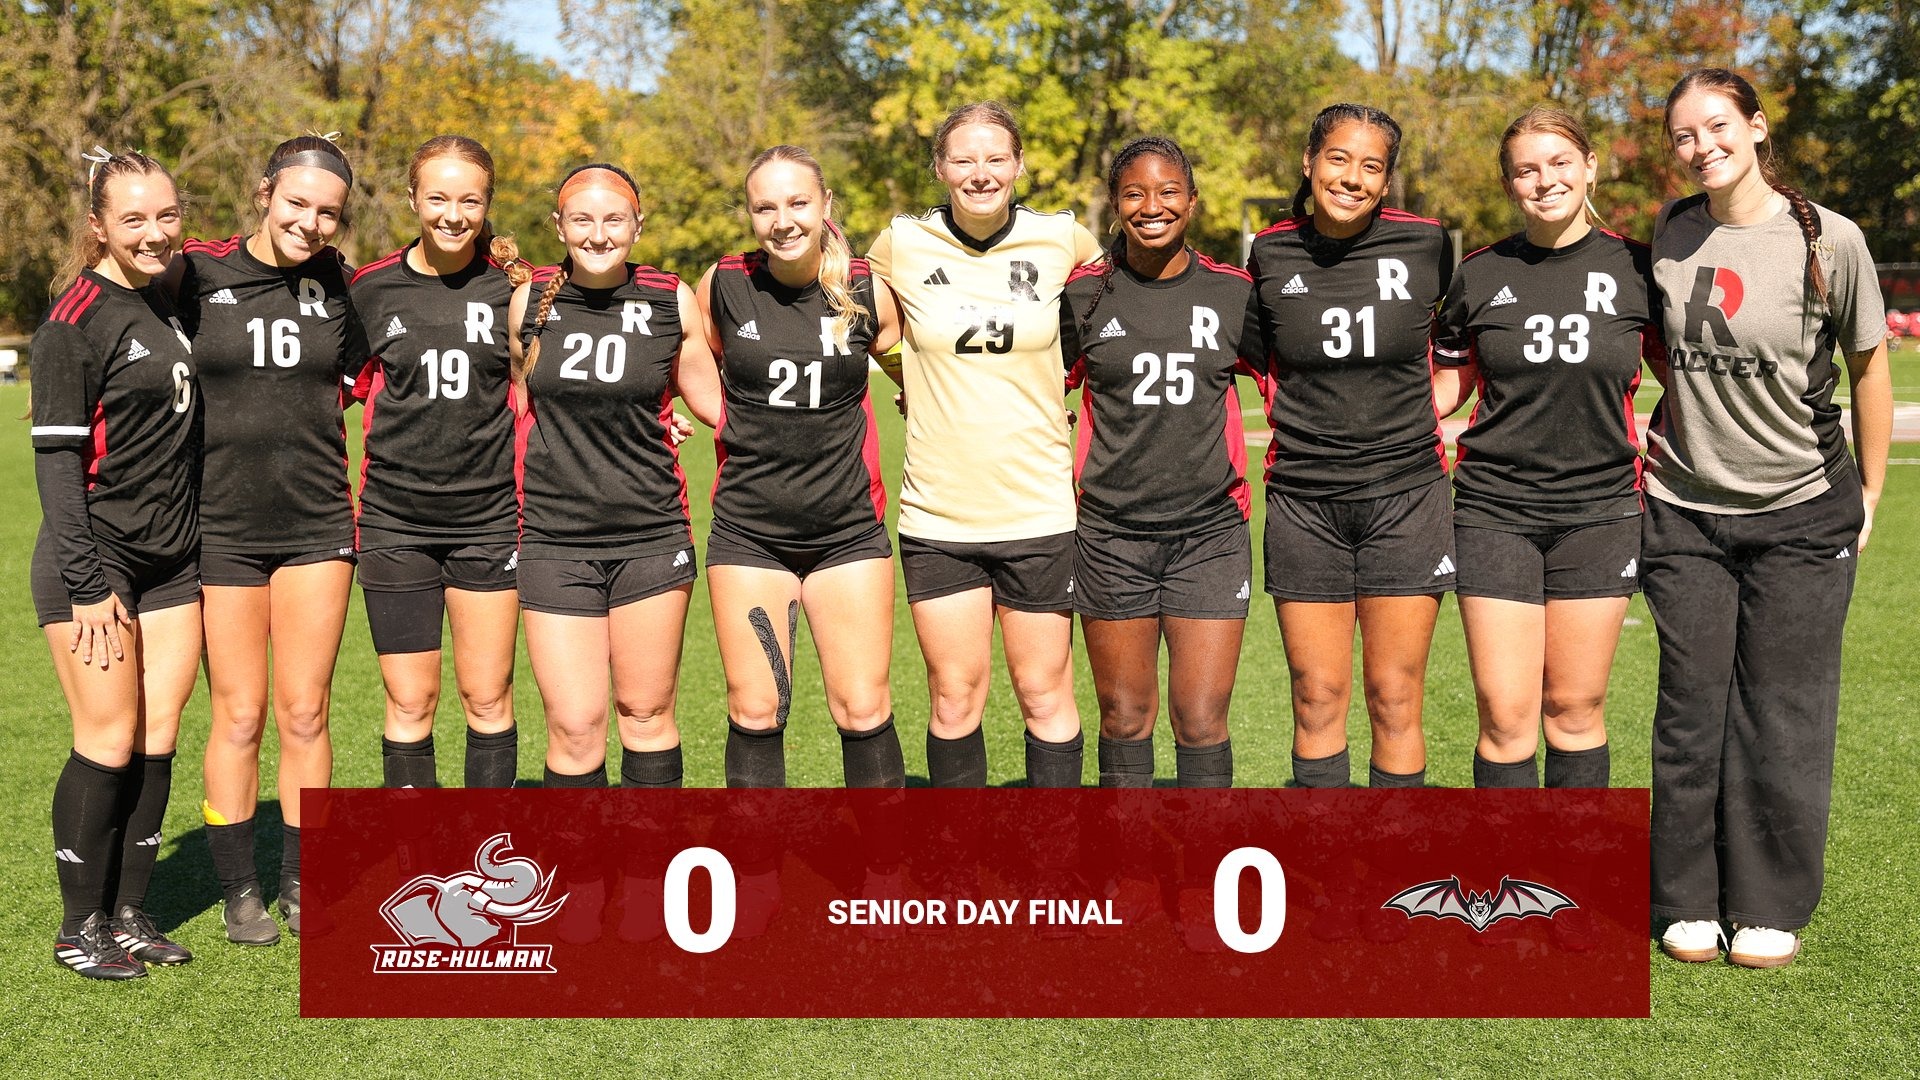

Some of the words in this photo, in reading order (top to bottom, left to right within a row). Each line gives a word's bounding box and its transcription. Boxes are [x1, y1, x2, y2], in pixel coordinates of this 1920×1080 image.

[208, 297, 238, 305] adidas
[297, 277, 330, 318] R
[1007, 260, 1041, 301] R
[1376, 258, 1412, 300] R
[1583, 271, 1618, 316] R
[463, 301, 496, 345] R
[620, 300, 653, 336] R
[1490, 297, 1518, 307] adidas
[1683, 265, 1744, 348] R
[246, 317, 301, 368] 16
[386, 327, 407, 338] adidas
[737, 329, 761, 340] adidas
[1099, 329, 1127, 338] adidas
[1189, 305, 1220, 351] R
[1321, 305, 1376, 359] 31
[1523, 313, 1590, 364] 33
[127, 348, 151, 361] adidas
[420, 348, 470, 400] 19
[559, 332, 627, 383] 20
[1670, 347, 1779, 380] OCCER
[172, 361, 191, 413] 6
[768, 358, 823, 409] 21
[1132, 352, 1196, 406] 25
